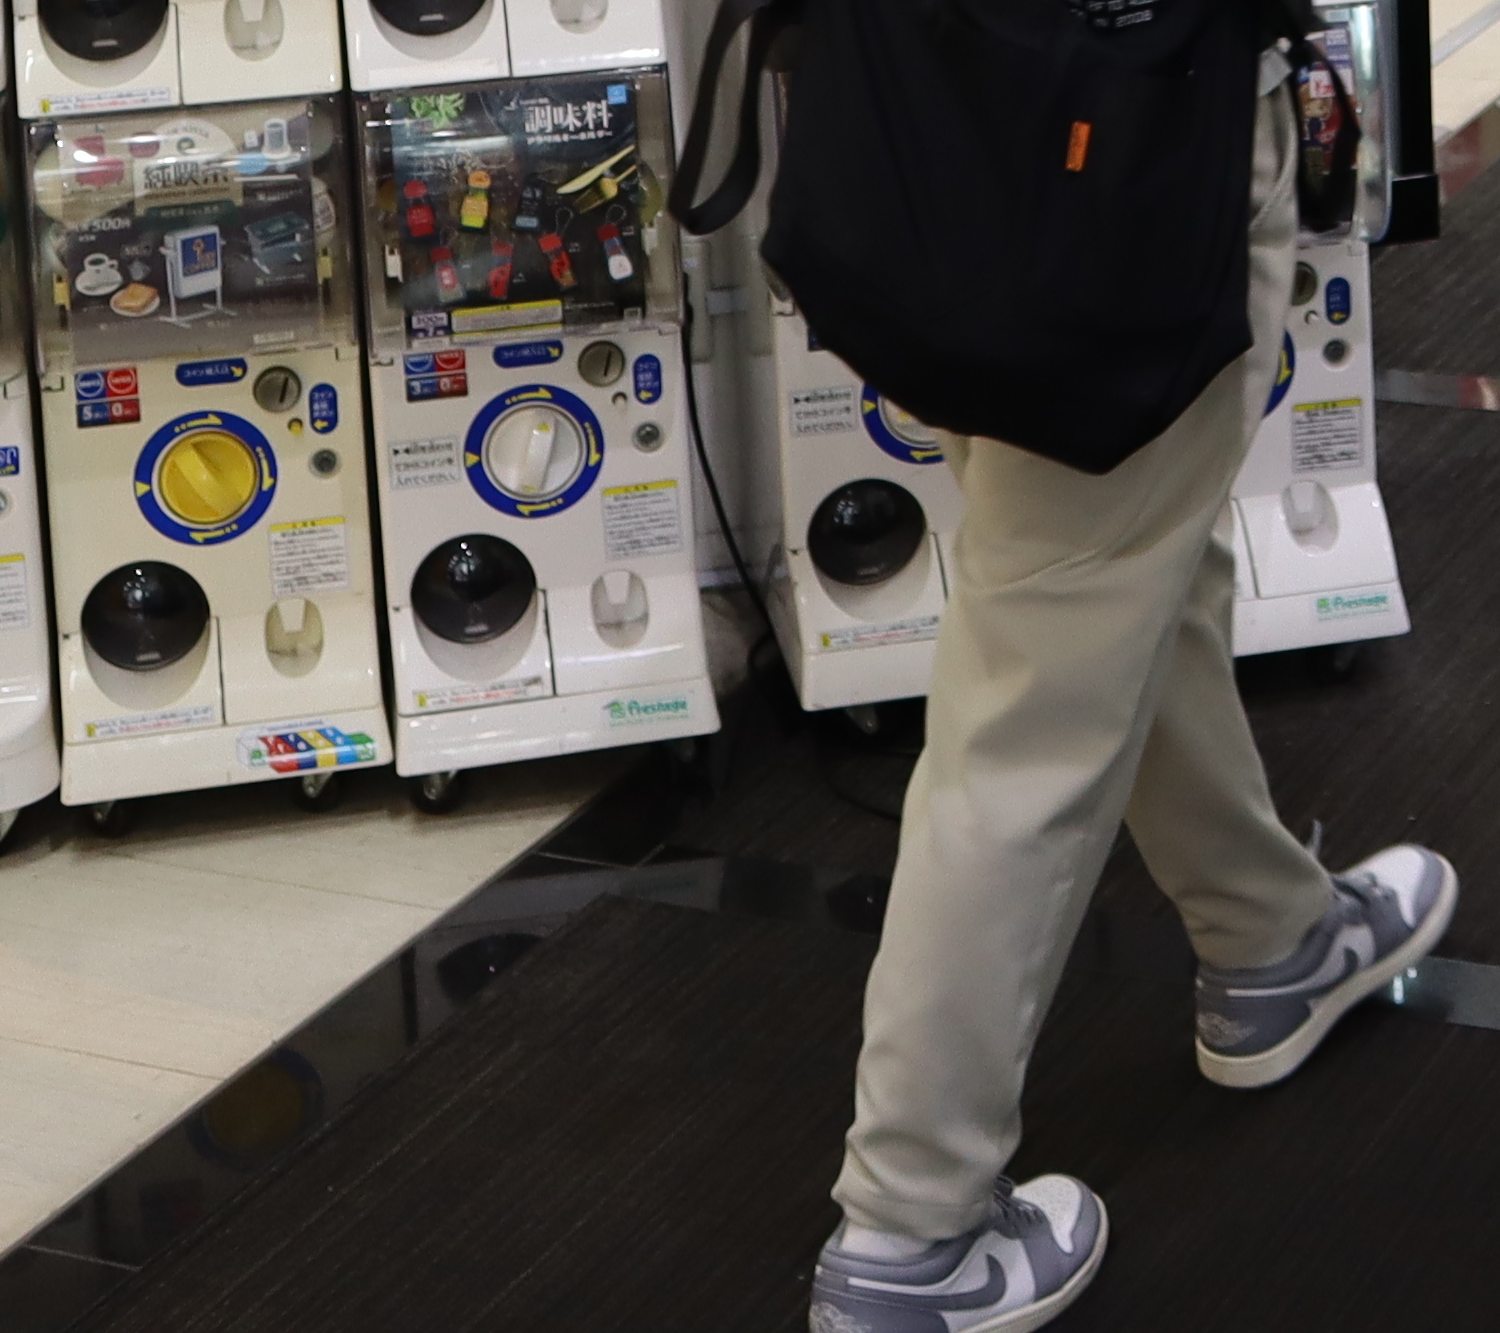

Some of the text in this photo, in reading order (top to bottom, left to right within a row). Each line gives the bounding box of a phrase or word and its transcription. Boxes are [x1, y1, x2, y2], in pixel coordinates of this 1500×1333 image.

[524, 99, 613, 133] 調味料
[143, 161, 230, 190] 純喫茶
